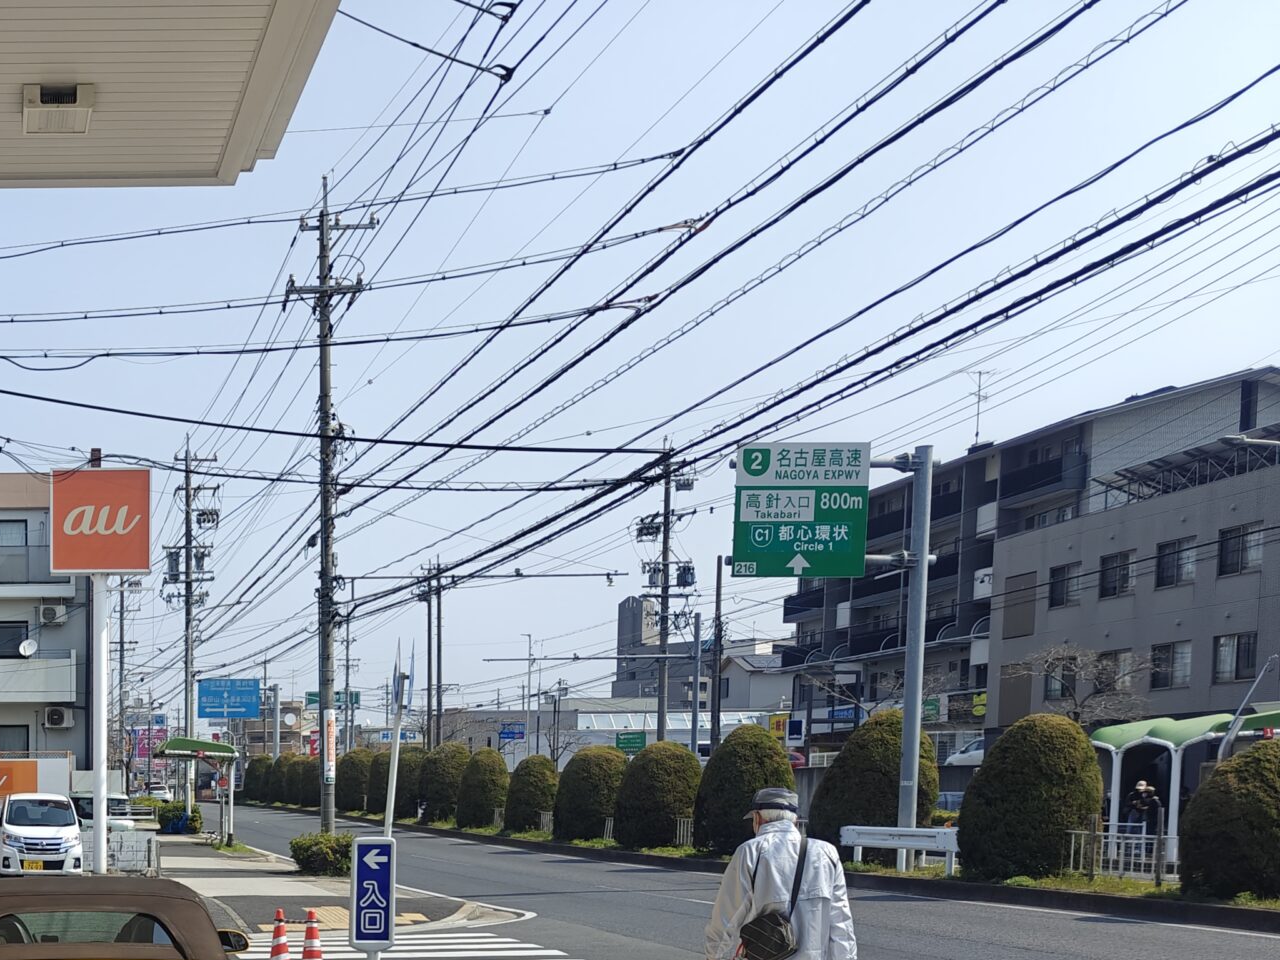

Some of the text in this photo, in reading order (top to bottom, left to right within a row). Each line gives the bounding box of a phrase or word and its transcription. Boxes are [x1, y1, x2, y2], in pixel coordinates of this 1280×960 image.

[751, 448, 862, 470] 2 名古屋高速
[775, 469, 861, 480] NAGOYA EXPWY
[745, 493, 810, 510] 高針入口
[820, 492, 863, 510] 800m
[63, 503, 142, 536] au
[754, 510, 801, 519] Takabari
[754, 525, 849, 541] C1 都心環状
[793, 542, 833, 551] Circle 1
[735, 563, 755, 574] 216
[359, 880, 387, 934] 入口
